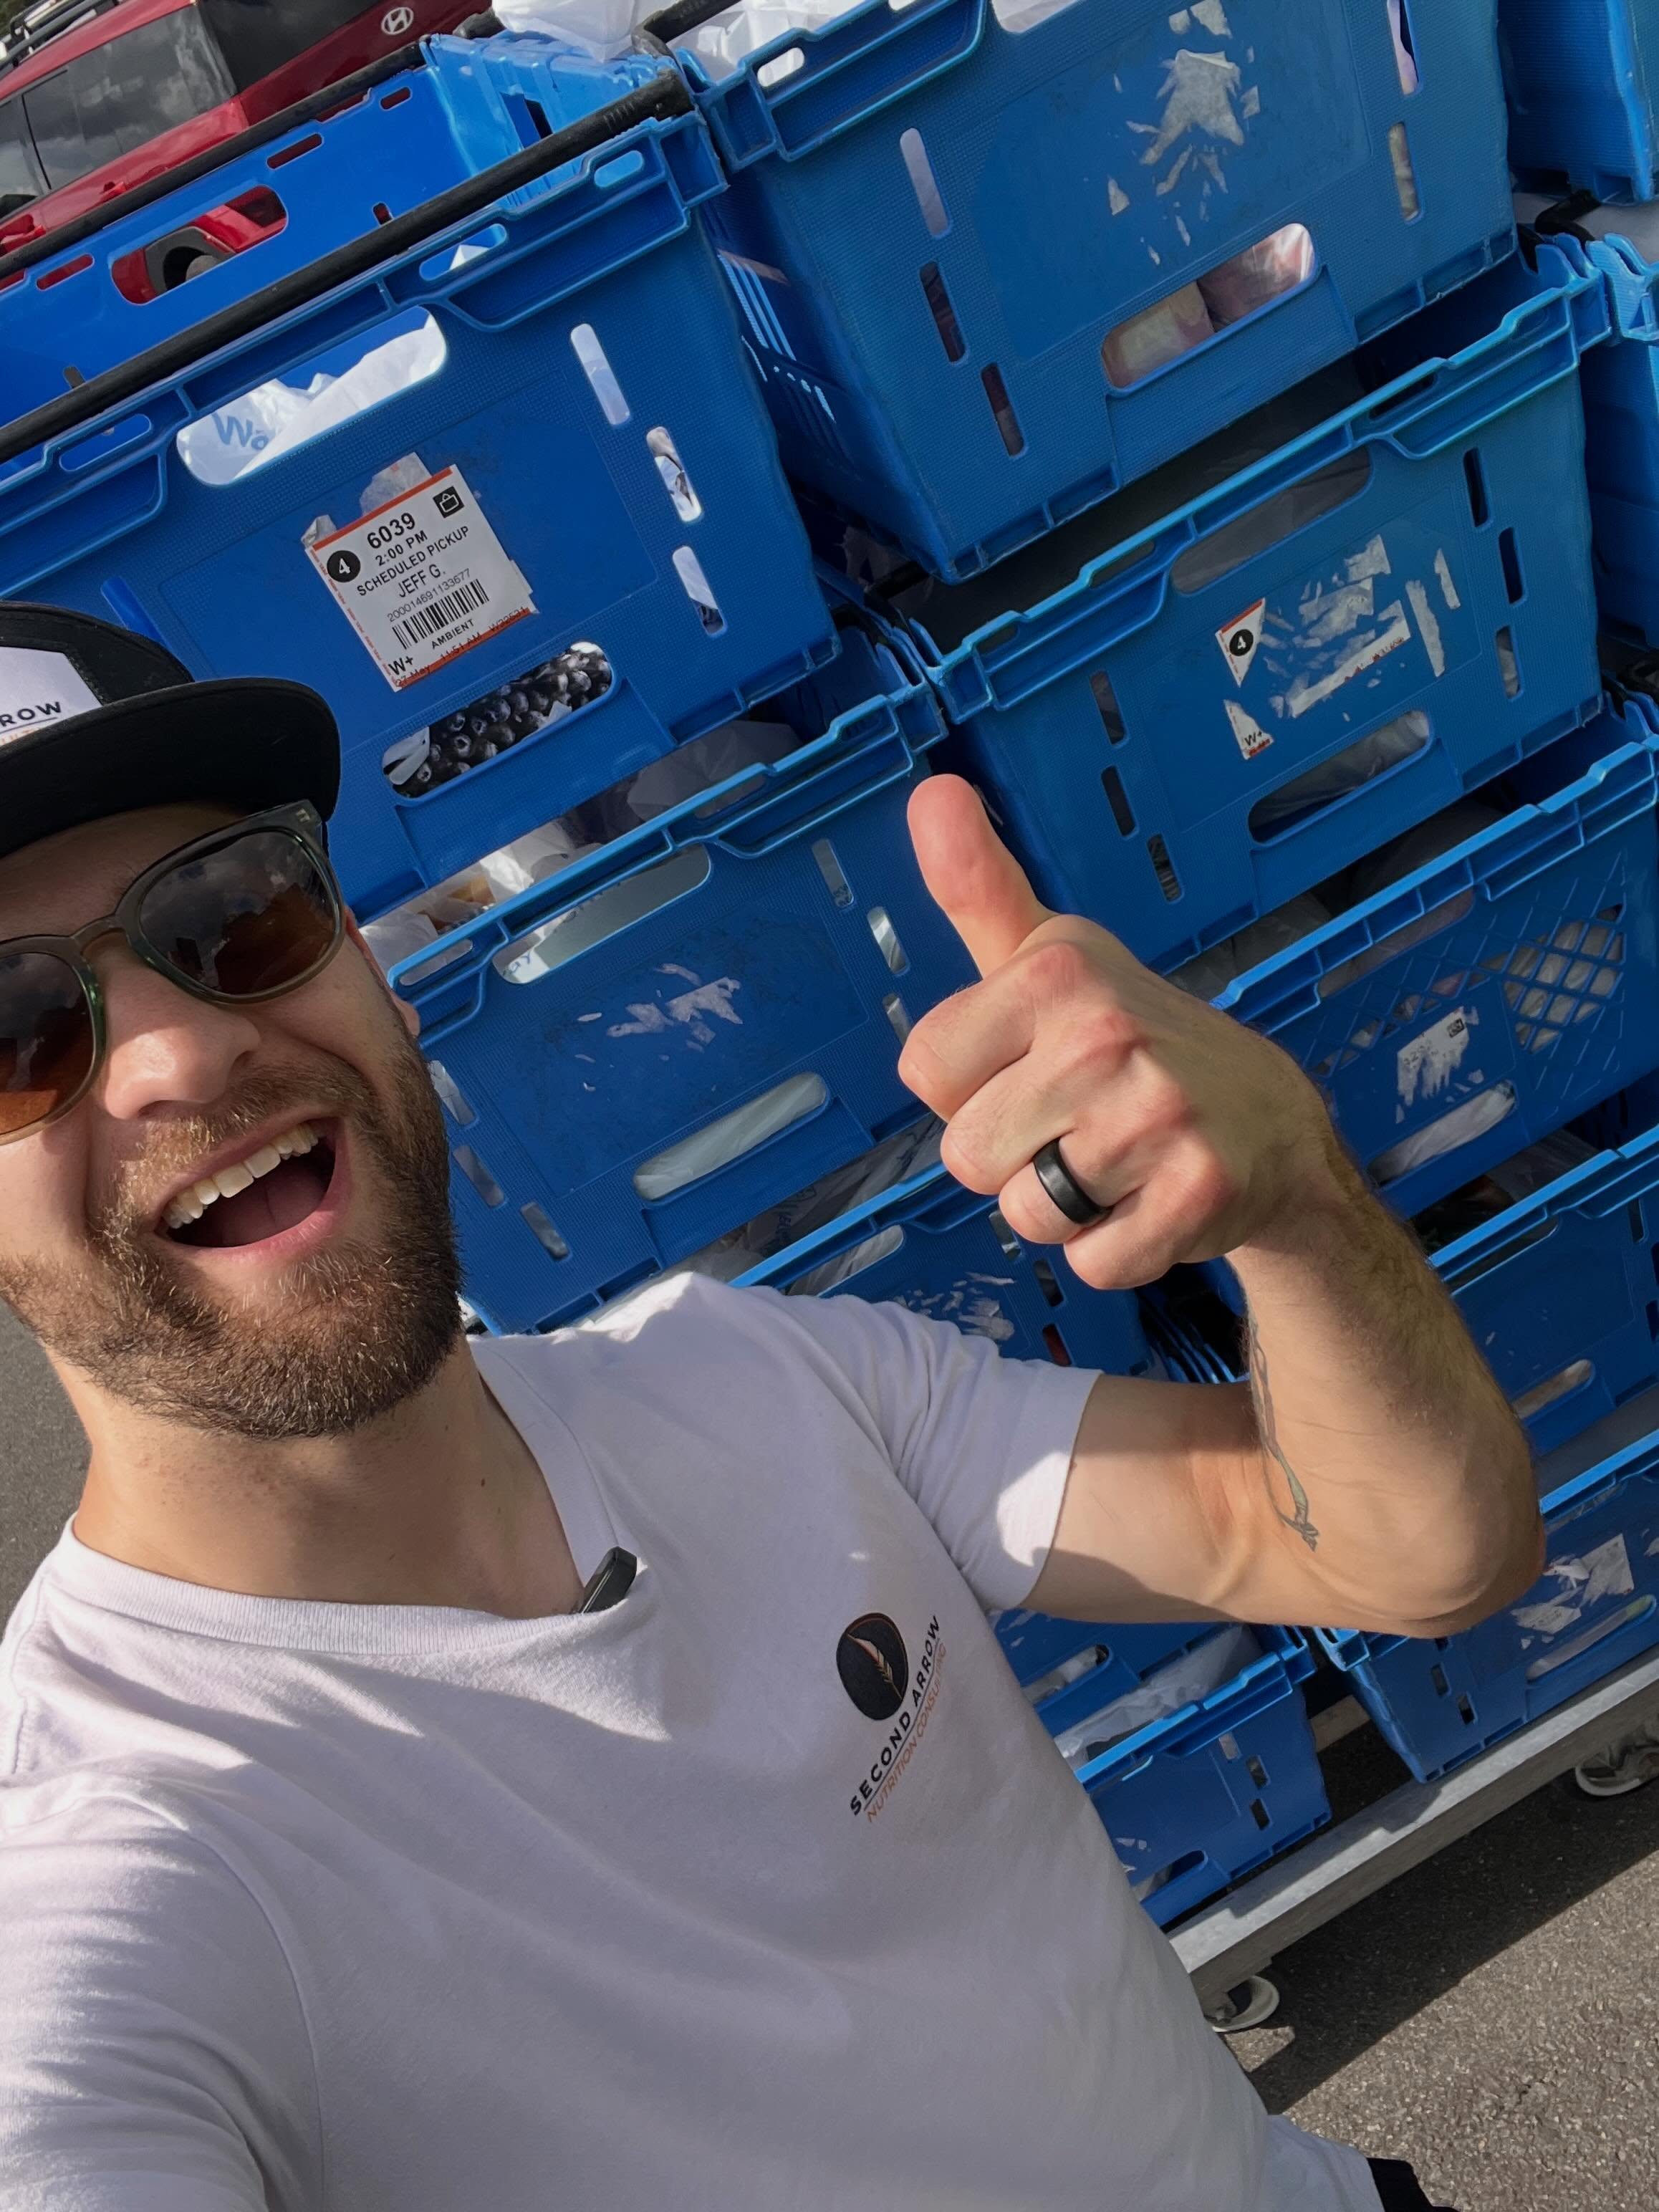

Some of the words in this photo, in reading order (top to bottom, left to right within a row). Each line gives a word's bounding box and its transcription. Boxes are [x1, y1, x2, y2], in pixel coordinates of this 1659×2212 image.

[367, 511, 416, 549] 6039
[375, 544, 404, 567] 2:00
[406, 529, 428, 550] PM
[357, 551, 426, 597] SCHEDULED
[427, 525, 470, 557] PICKUP
[387, 568, 471, 622] 200014691133677
[398, 570, 428, 598] JEFF
[429, 563, 446, 580] G.
[431, 618, 476, 650] AMBIENT
[388, 656, 413, 675] W+
[850, 1711, 911, 1815] SECOND
[912, 1615, 940, 1707] ARROW
[867, 1736, 917, 1823] NUTRITION
